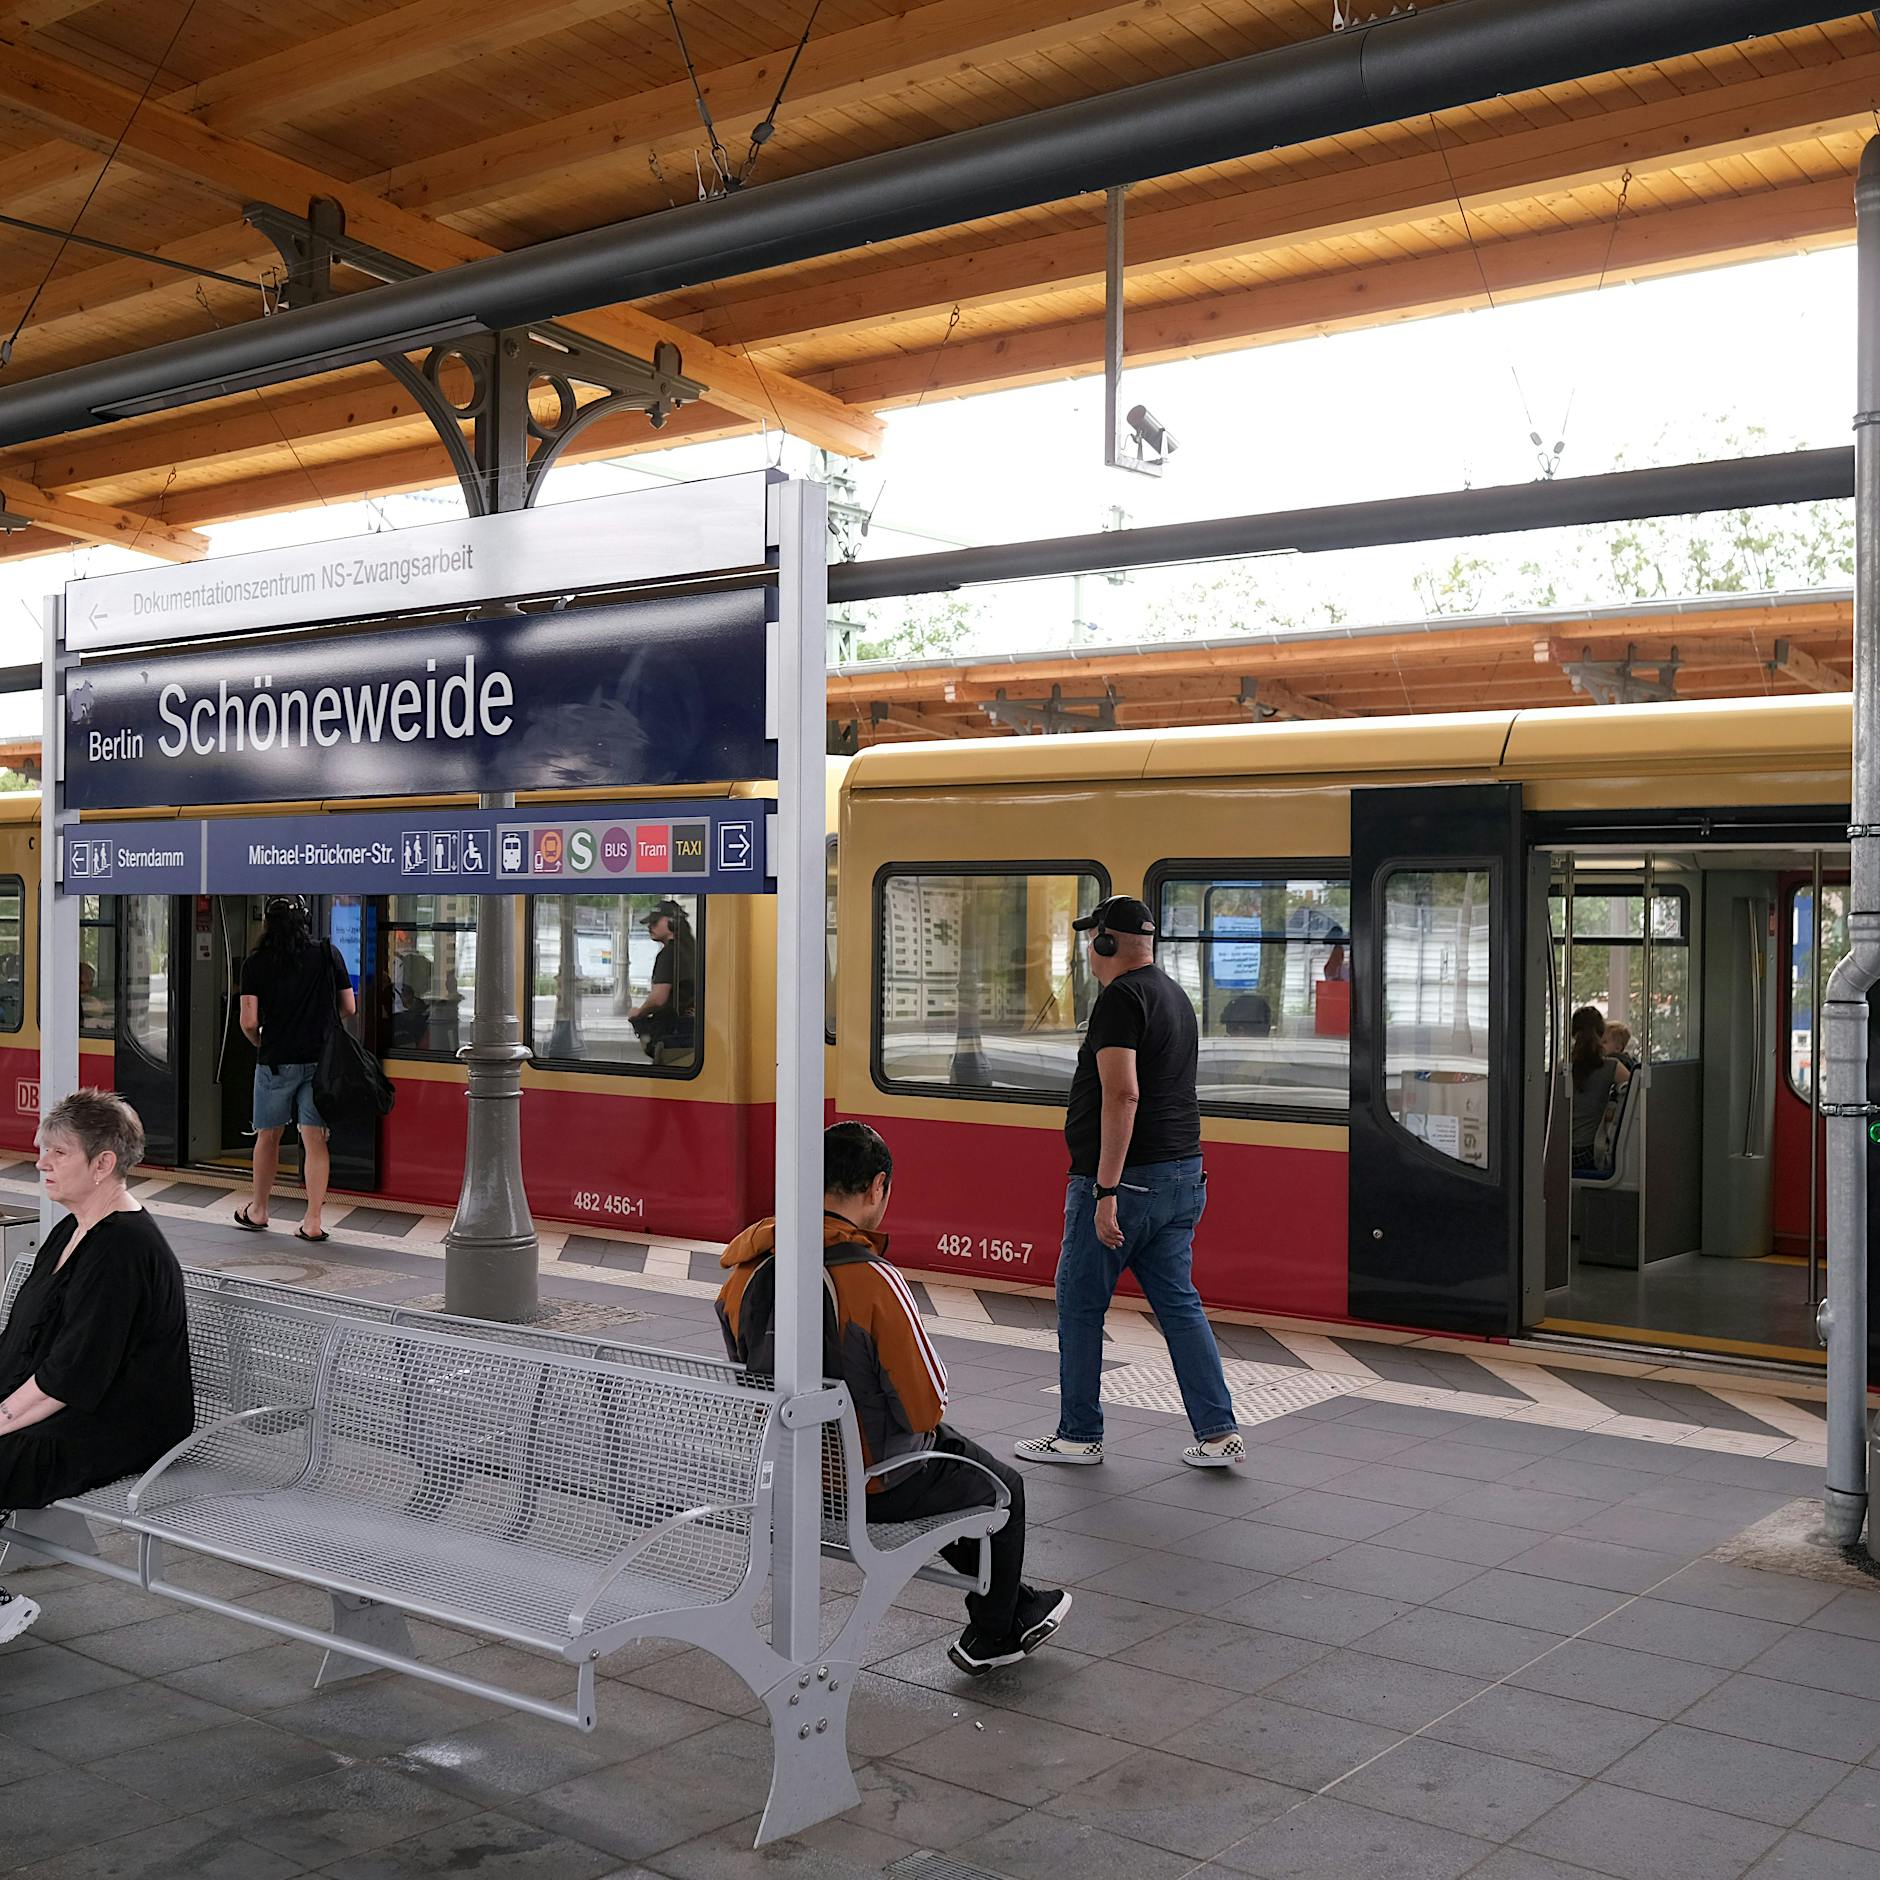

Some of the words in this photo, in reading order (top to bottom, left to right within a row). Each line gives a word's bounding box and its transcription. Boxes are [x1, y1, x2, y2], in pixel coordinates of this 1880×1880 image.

[132, 570, 317, 616] Dokumentationszentrum
[320, 544, 474, 593] NS-Zwangsarbeit
[88, 729, 144, 762] Berlin
[157, 654, 514, 758] Schöneweide
[117, 848, 184, 868] Sterndamm
[248, 842, 396, 866] Michael-Brückner-Str.
[571, 831, 593, 870] S
[605, 842, 628, 857] BUS
[638, 841, 667, 857] Tram
[676, 840, 702, 856] TAXI
[19, 1084, 39, 1109] DB
[573, 1191, 600, 1211] 482
[603, 1194, 643, 1217] 456-1
[937, 1233, 972, 1257] 482
[978, 1238, 1033, 1264] 156-7
